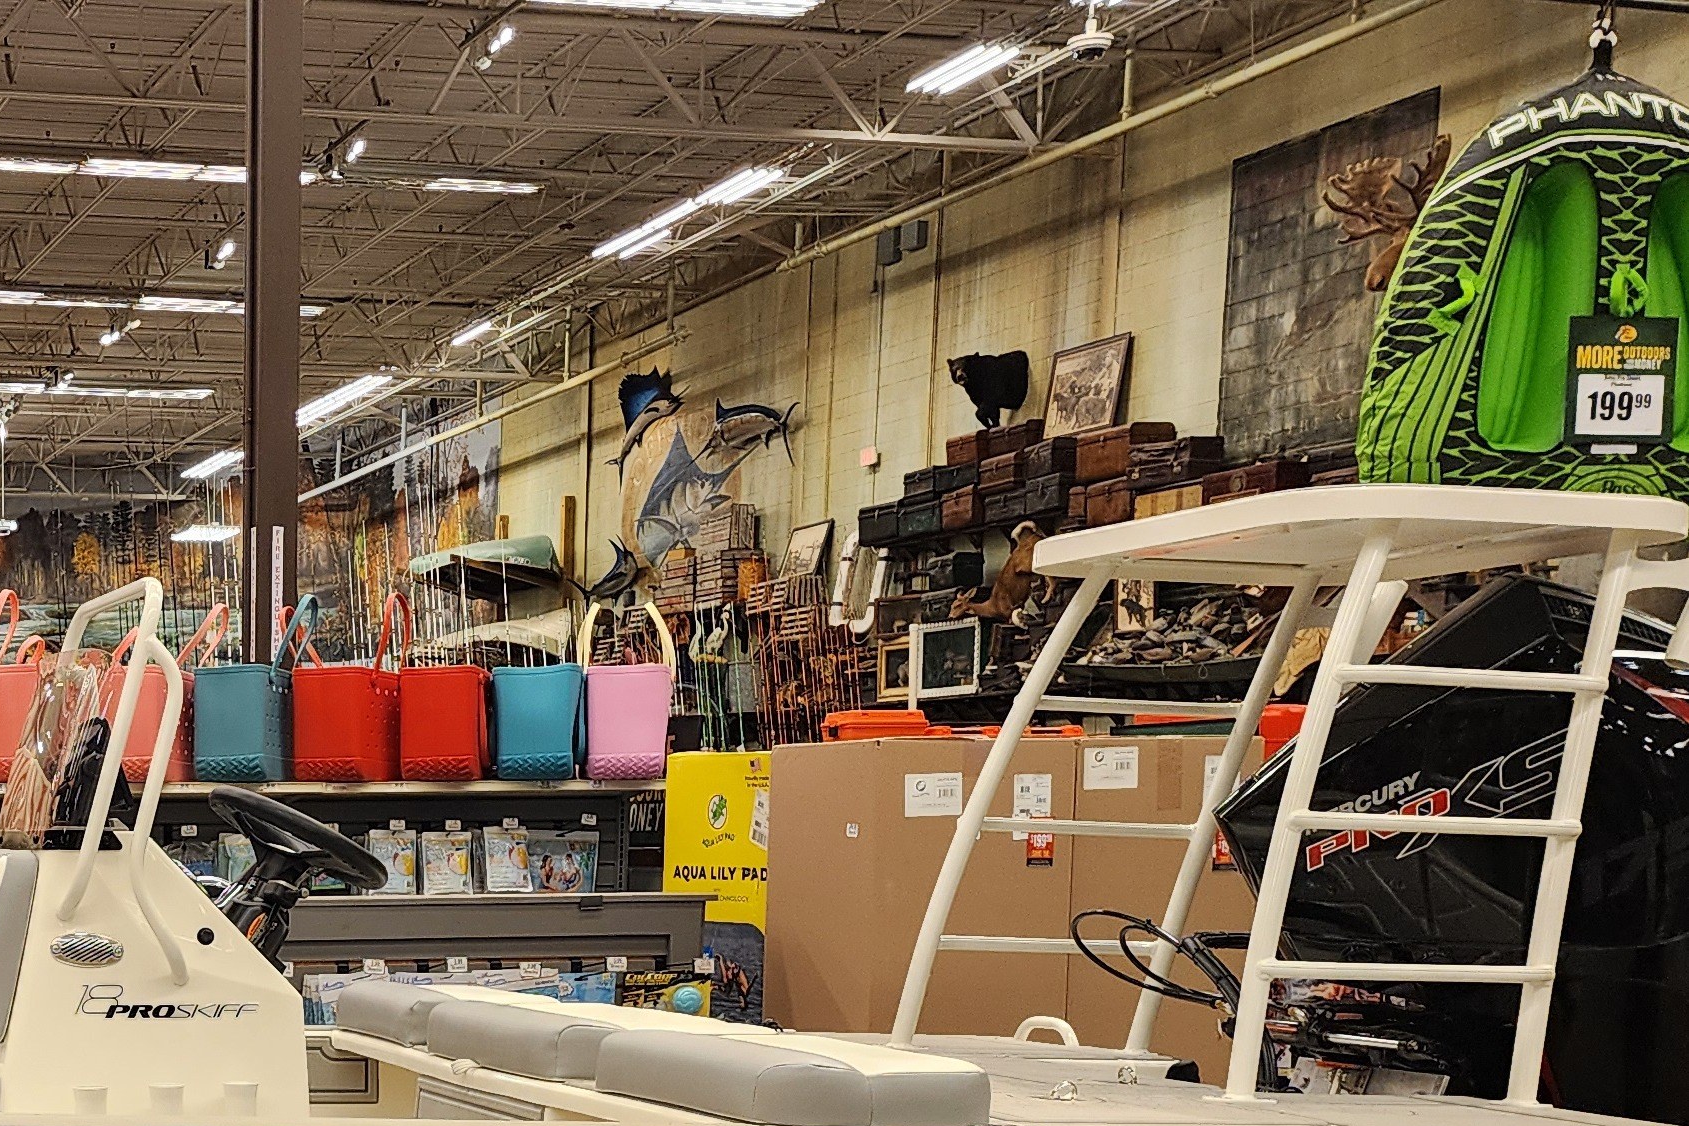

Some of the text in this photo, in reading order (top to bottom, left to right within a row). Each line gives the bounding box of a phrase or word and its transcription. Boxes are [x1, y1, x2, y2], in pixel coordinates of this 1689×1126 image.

[1576, 345, 1623, 369] MORE
[630, 803, 664, 832] ONEY
[673, 865, 768, 882] AQUA LILY PAD
[75, 984, 123, 1014] 18
